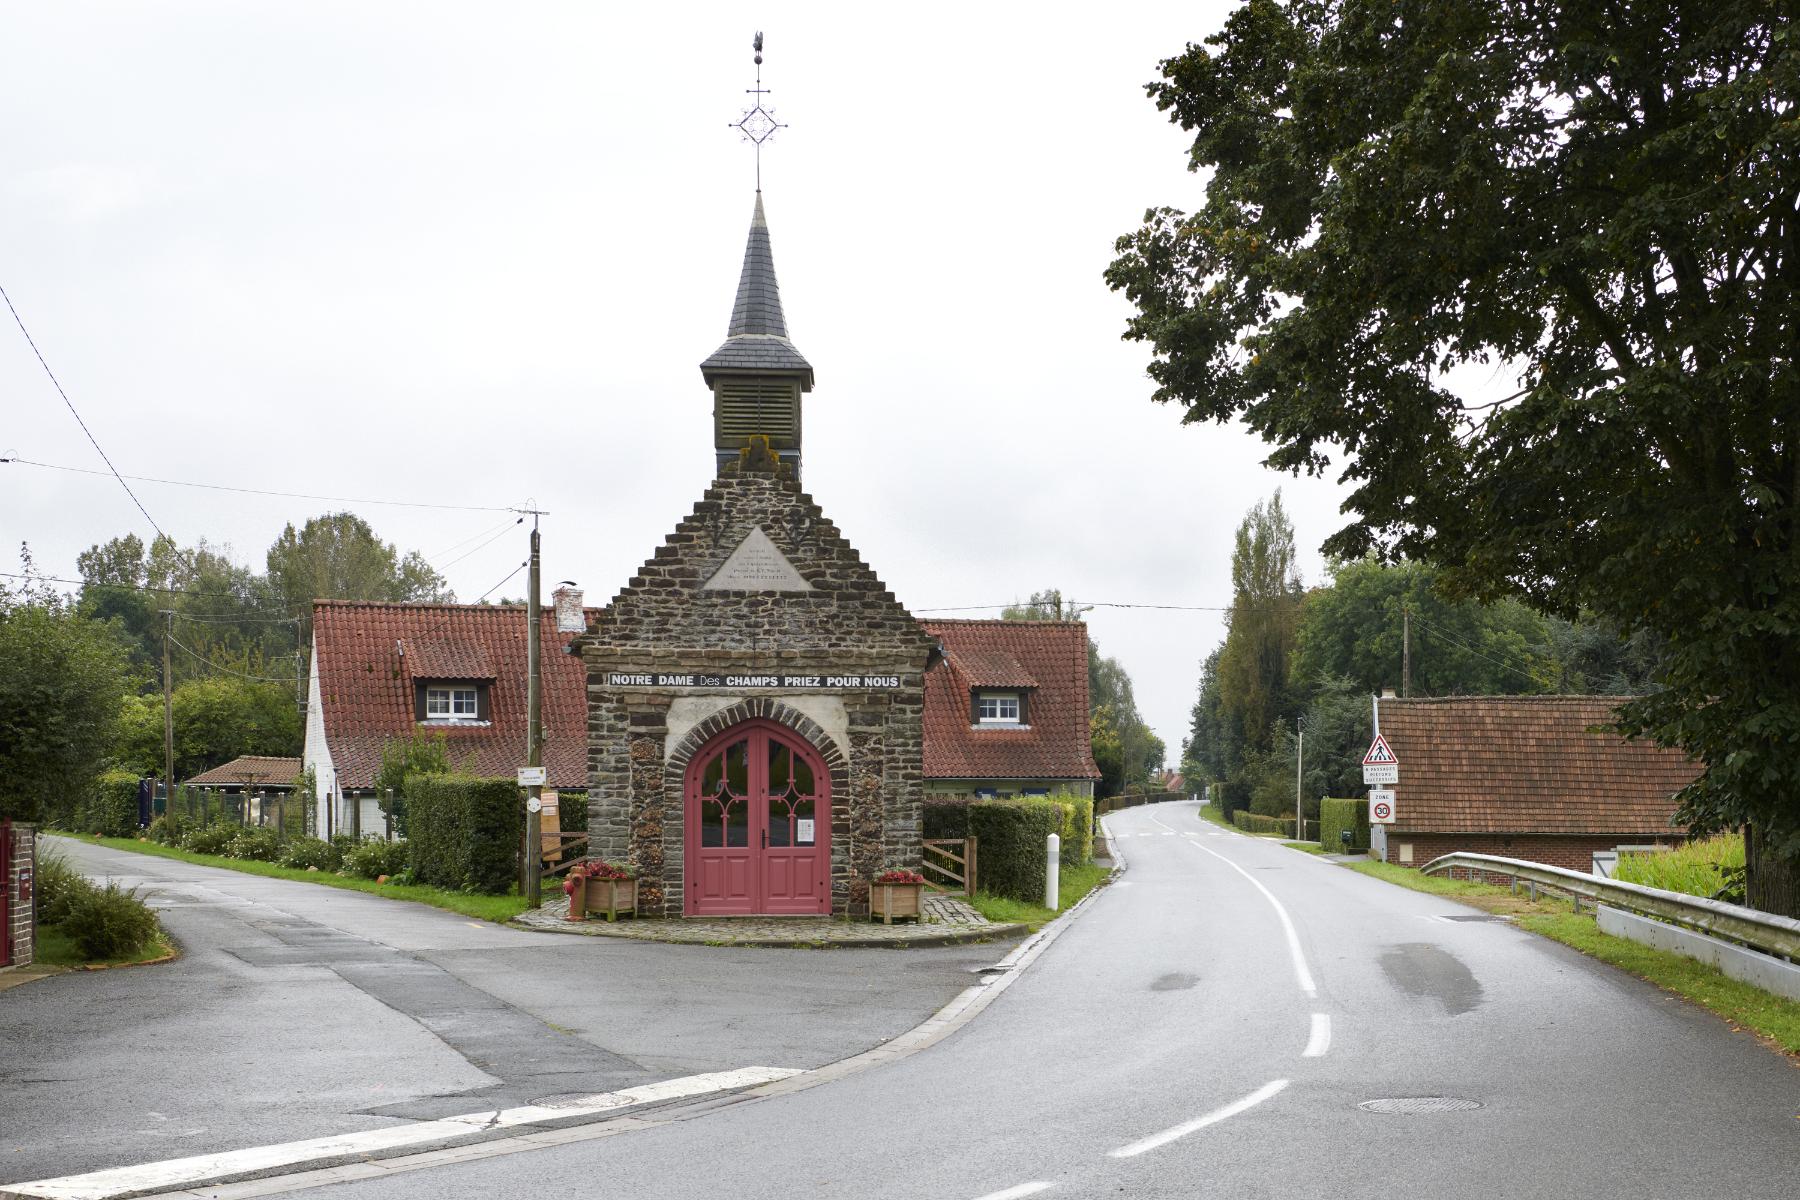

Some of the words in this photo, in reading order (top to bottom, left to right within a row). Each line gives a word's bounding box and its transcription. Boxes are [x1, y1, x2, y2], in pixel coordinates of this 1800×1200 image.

[611, 675, 652, 685] NOTRE
[658, 675, 694, 686] DAME
[700, 675, 720, 686] Des
[726, 676, 778, 686] CHAMPS
[784, 676, 820, 687] PRIEZ
[826, 676, 861, 687] POUR
[864, 676, 899, 687] NOUS
[1377, 807, 1388, 815] 30
